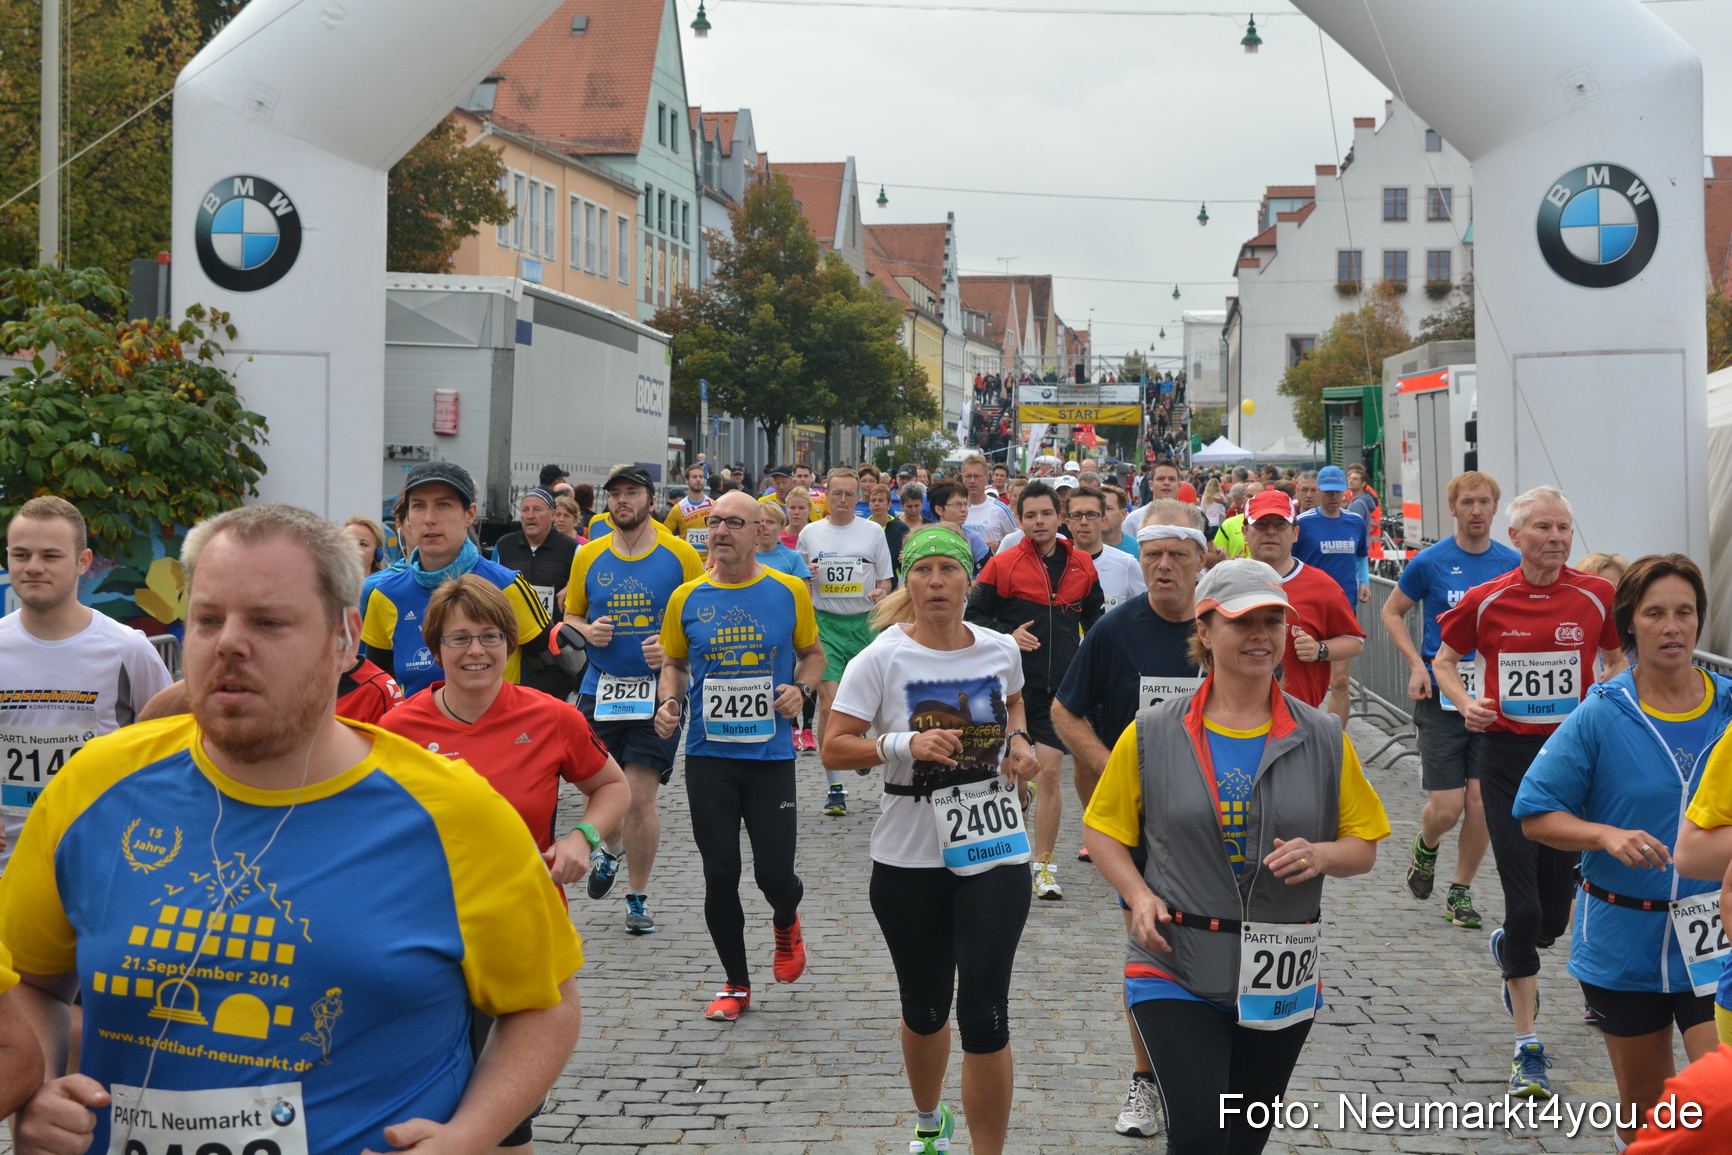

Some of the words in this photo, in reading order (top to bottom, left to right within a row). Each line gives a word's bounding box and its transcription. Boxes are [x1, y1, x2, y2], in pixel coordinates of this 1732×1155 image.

[1546, 165, 1651, 209] BMW
[202, 177, 294, 217] BMW
[636, 375, 664, 416] BOCK
[1058, 409, 1101, 420] START
[1320, 540, 1356, 550] HUBER
[827, 566, 854, 582] 637
[825, 584, 858, 594] Stefan
[711, 644, 748, 652] 21.September
[405, 660, 432, 668] GRAMMER
[1529, 658, 1567, 667] Neumarkt
[727, 683, 762, 692] Neumarkt
[1142, 685, 1173, 694] PARTL
[1508, 668, 1573, 697] 2613
[601, 681, 650, 701] 2620
[77, 704, 95, 712] BÜRO
[710, 693, 768, 719] 2426
[1527, 702, 1555, 714] Horst
[722, 724, 758, 734] Norbert
[915, 715, 941, 729] 11.
[30, 734, 79, 745] Neumarkt
[7, 747, 83, 782] 214
[965, 785, 1004, 801] Neumarkt
[946, 797, 1018, 842] 2406
[148, 827, 163, 839] 15
[133, 840, 167, 855] Jahre
[967, 841, 1012, 862] Claudia
[1673, 903, 1710, 919] PARTL
[1244, 933, 1283, 945] PARTL
[121, 955, 244, 982] 21.September
[248, 971, 290, 988] 2014
[1251, 944, 1318, 990] 2082
[1273, 995, 1299, 1016] Birgit
[98, 1027, 314, 1073] www.stadtlauf-neumarkt.de
[114, 1105, 158, 1129] PARTL
[162, 1109, 263, 1131] Neumarkt
